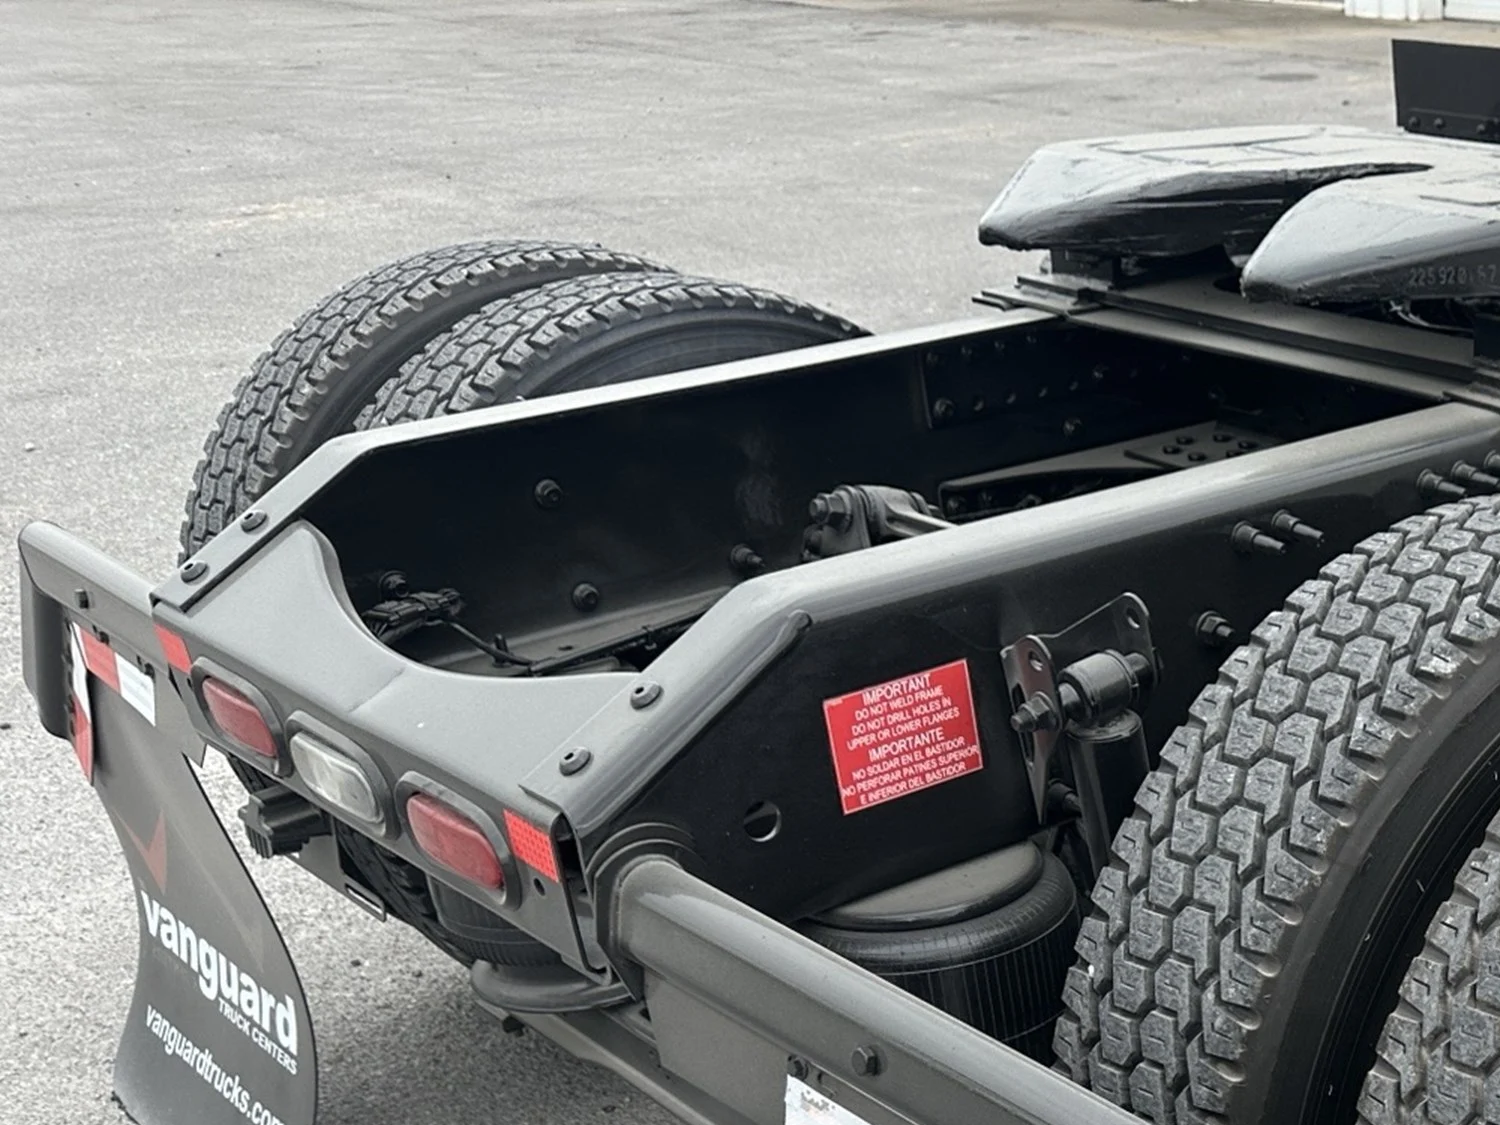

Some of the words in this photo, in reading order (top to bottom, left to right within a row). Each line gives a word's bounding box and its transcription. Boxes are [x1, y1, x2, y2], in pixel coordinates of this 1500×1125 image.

[855, 708, 869, 721] DO
[870, 704, 888, 717] NOT
[890, 697, 913, 712] WELD
[915, 685, 944, 702] FRAME
[862, 673, 931, 706] IMPORTANT
[847, 735, 876, 751] UPPER
[877, 729, 891, 741] OR
[892, 720, 922, 737] LOWER
[923, 706, 960, 727] FLANGES
[852, 724, 865, 736] DO
[867, 719, 885, 732] NOT
[887, 711, 911, 727] DRILL
[912, 701, 940, 718] HOLES
[940, 696, 952, 708] IN
[852, 769, 866, 781] NO
[867, 758, 900, 777] SOLDAR
[901, 754, 913, 766] EN
[914, 750, 925, 762] EL
[926, 736, 965, 758] BASTIDOR
[868, 727, 945, 762] IMPORTANTE
[842, 786, 856, 798] NO
[857, 769, 902, 792] PERFORAR
[903, 759, 937, 777] PATINES
[938, 745, 979, 766] SUPERIOR
[860, 793, 867, 805] E
[868, 781, 907, 803] INFERIOR
[908, 775, 924, 790] DEL
[925, 761, 966, 783] BASTIDOR
[141, 890, 297, 1056] vanguard
[218, 996, 250, 1037] TRUCK
[251, 1027, 297, 1075] CENTERS
